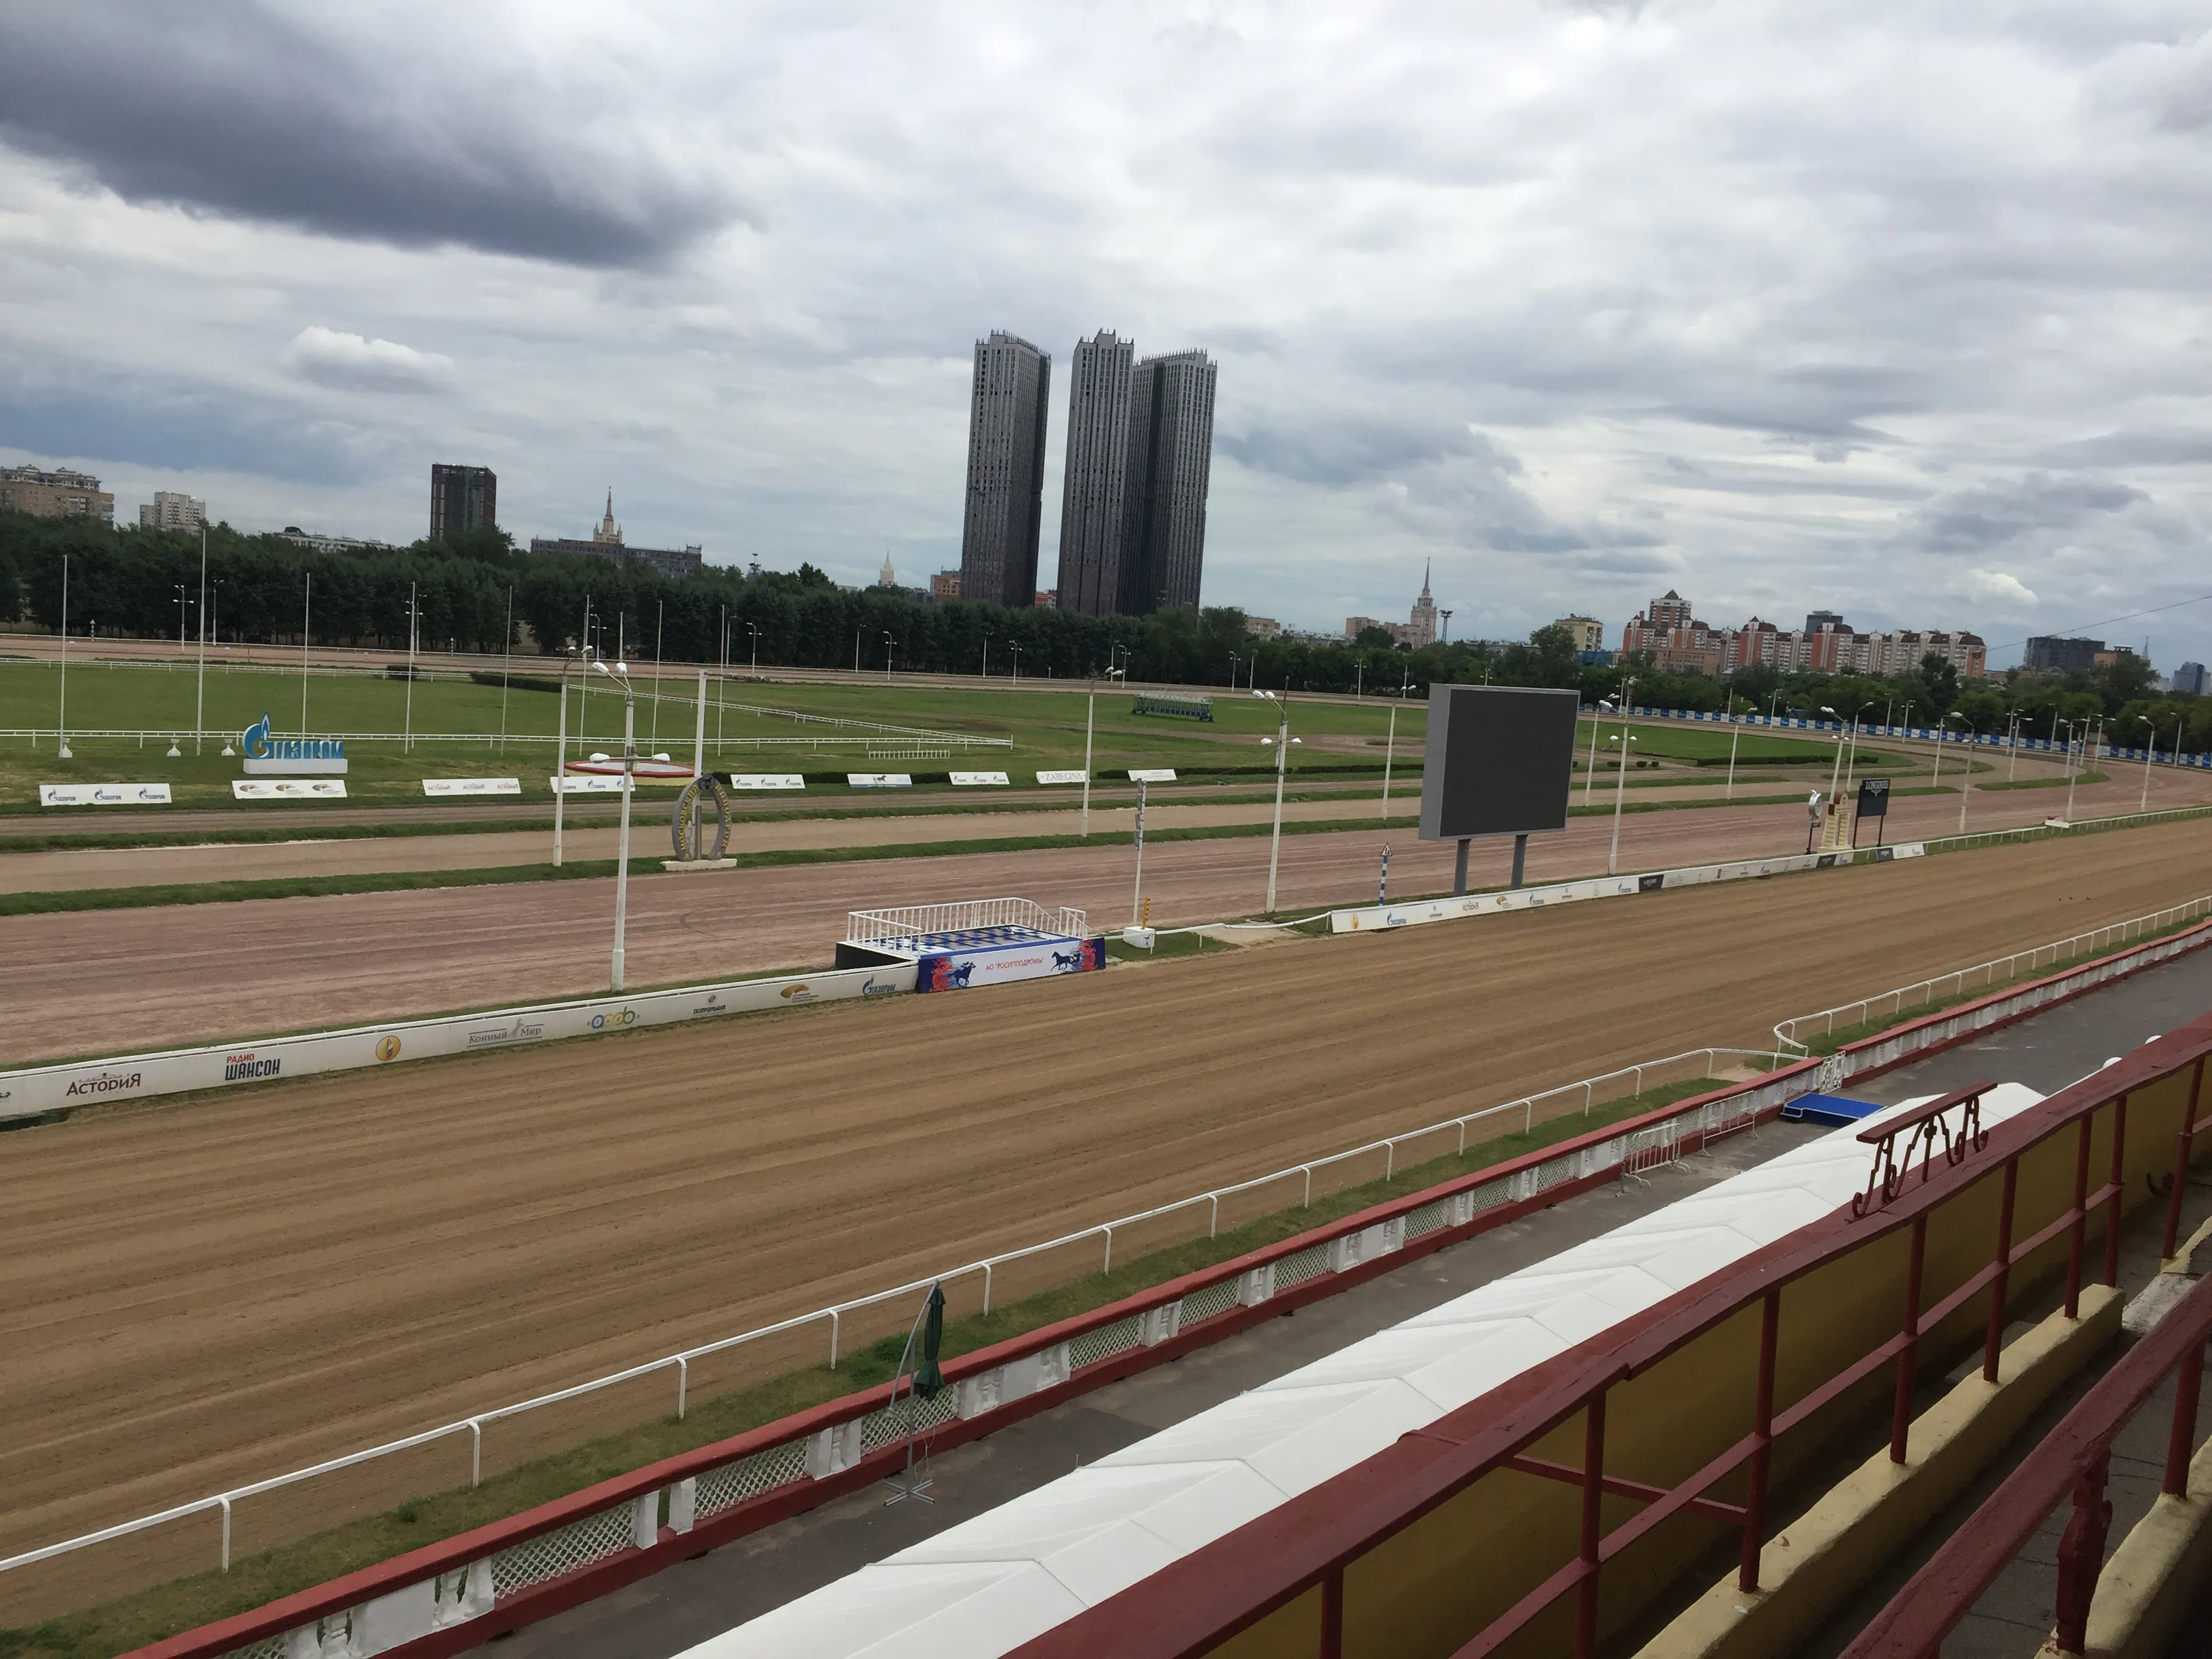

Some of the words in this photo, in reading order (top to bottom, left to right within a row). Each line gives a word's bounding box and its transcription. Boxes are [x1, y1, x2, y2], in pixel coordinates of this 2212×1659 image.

[274, 741, 345, 760] ГАЗПРОМ
[469, 1031, 508, 1044] Конный
[520, 1027, 541, 1037] Мир
[226, 1053, 255, 1063] РАДИО
[224, 1058, 281, 1081] ШАНСОН
